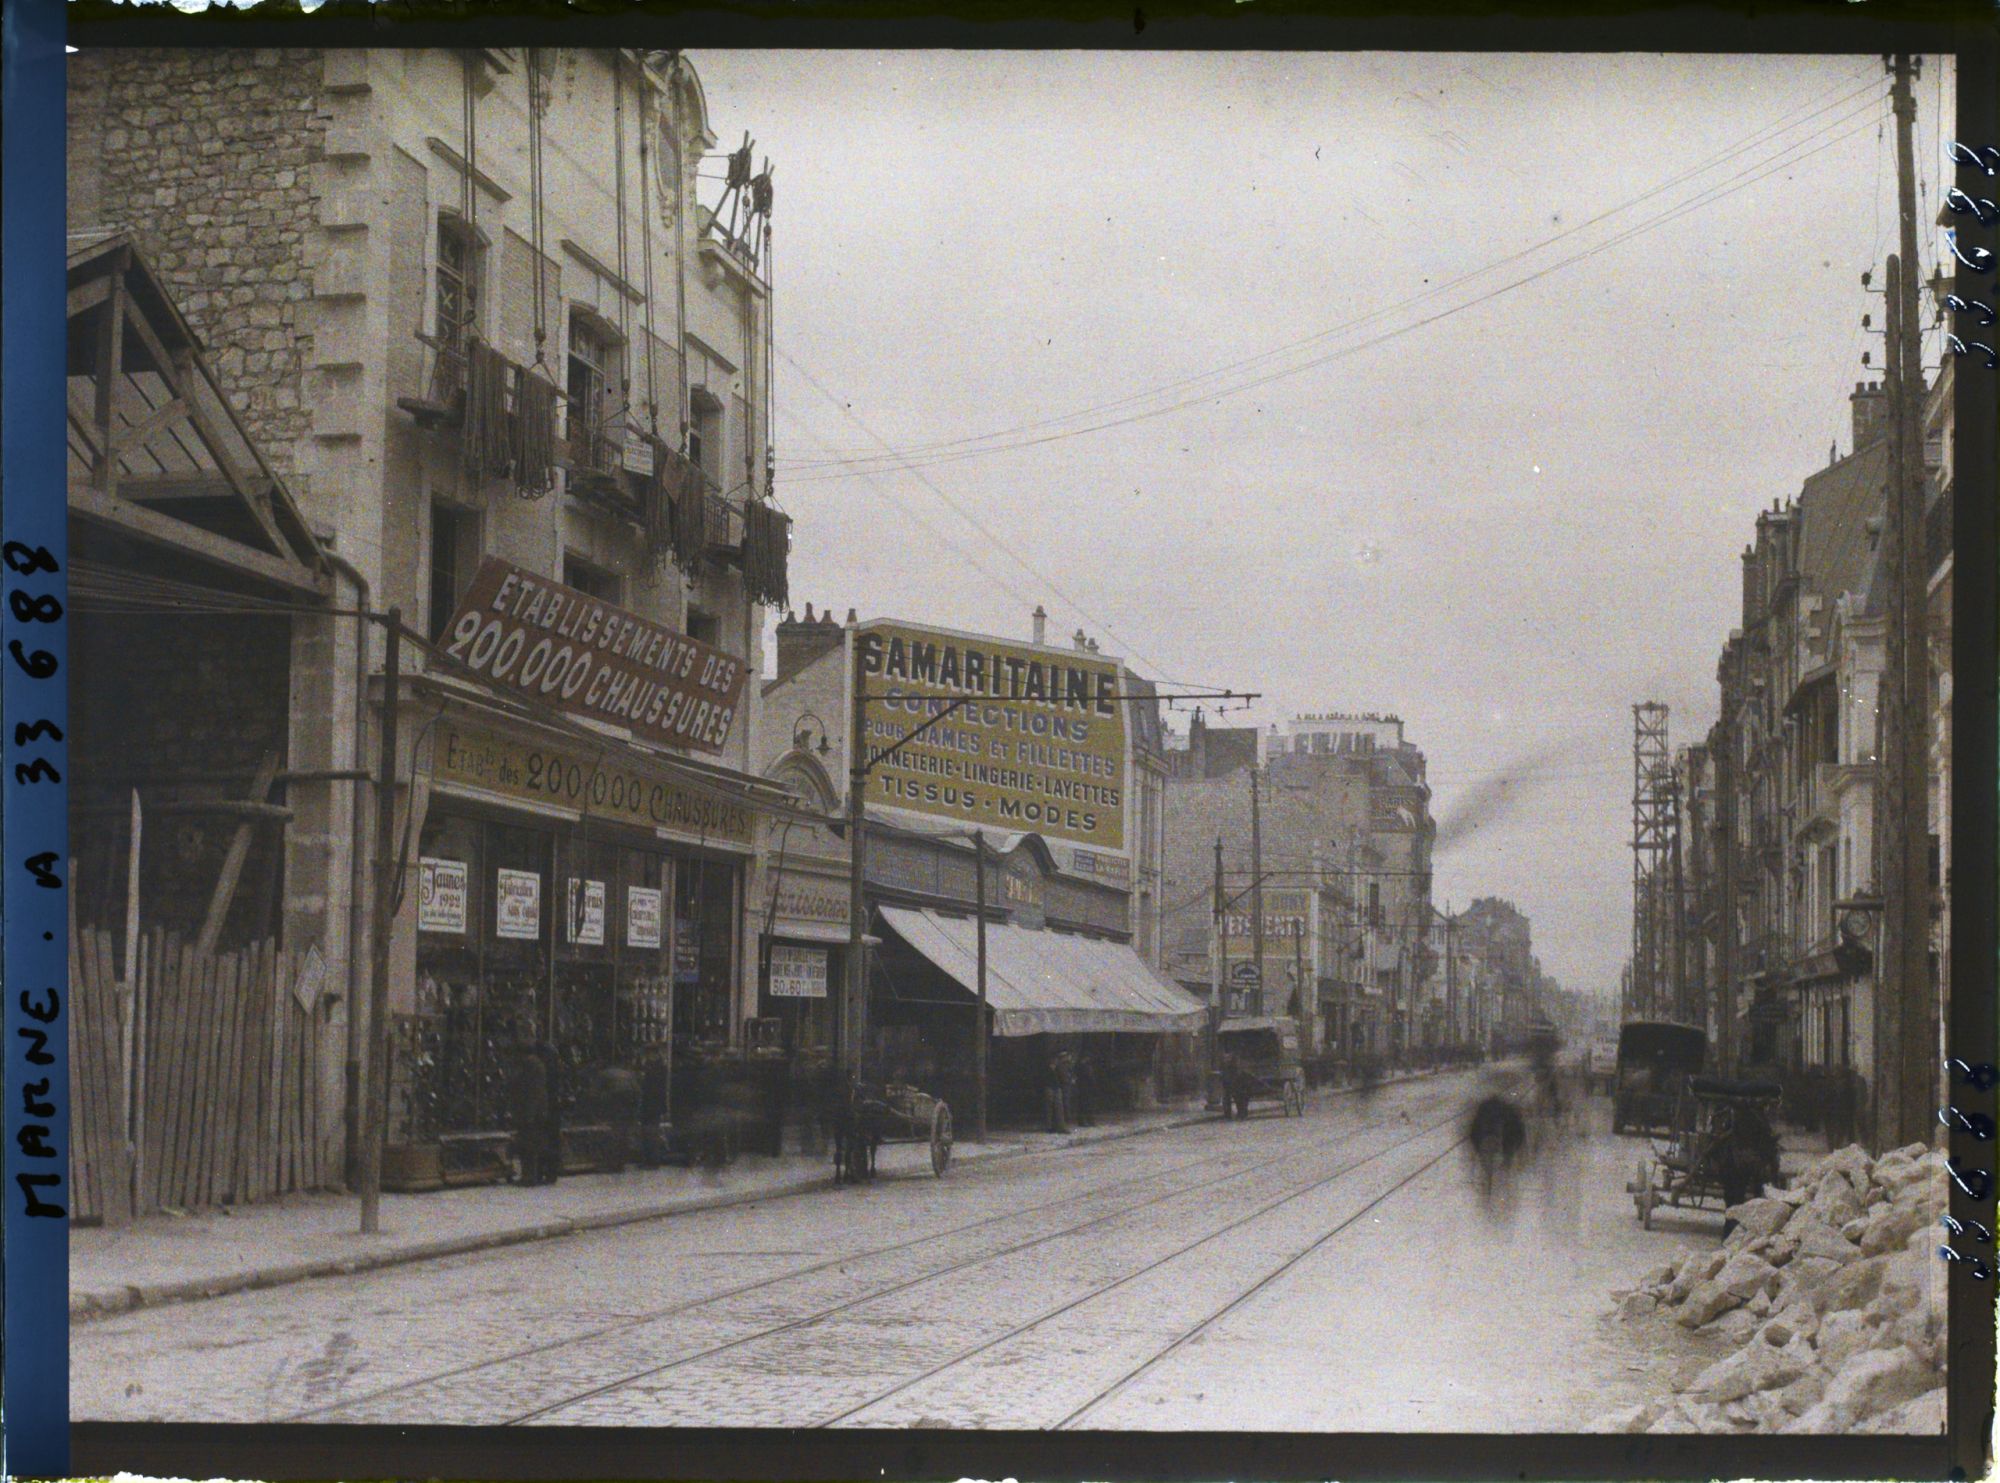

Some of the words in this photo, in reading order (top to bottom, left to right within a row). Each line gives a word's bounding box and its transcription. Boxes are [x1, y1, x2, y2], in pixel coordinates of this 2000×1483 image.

[700, 659, 738, 694] DES
[858, 632, 1116, 717] SAMARITAINE
[585, 665, 734, 746] CHAUSSURES
[914, 722, 980, 753] DAMES
[990, 739, 1009, 760] ET
[1017, 741, 1116, 778] FILLETTES
[651, 784, 746, 835] CHAUSSURES
[881, 775, 976, 809] TISSUS
[1000, 797, 1097, 831] MODES
[964, 760, 1034, 791] LINGERIE
[1044, 775, 1120, 807] LAYETTES
[25, 851, 63, 888] A
[17, 987, 66, 1218] MARNE
